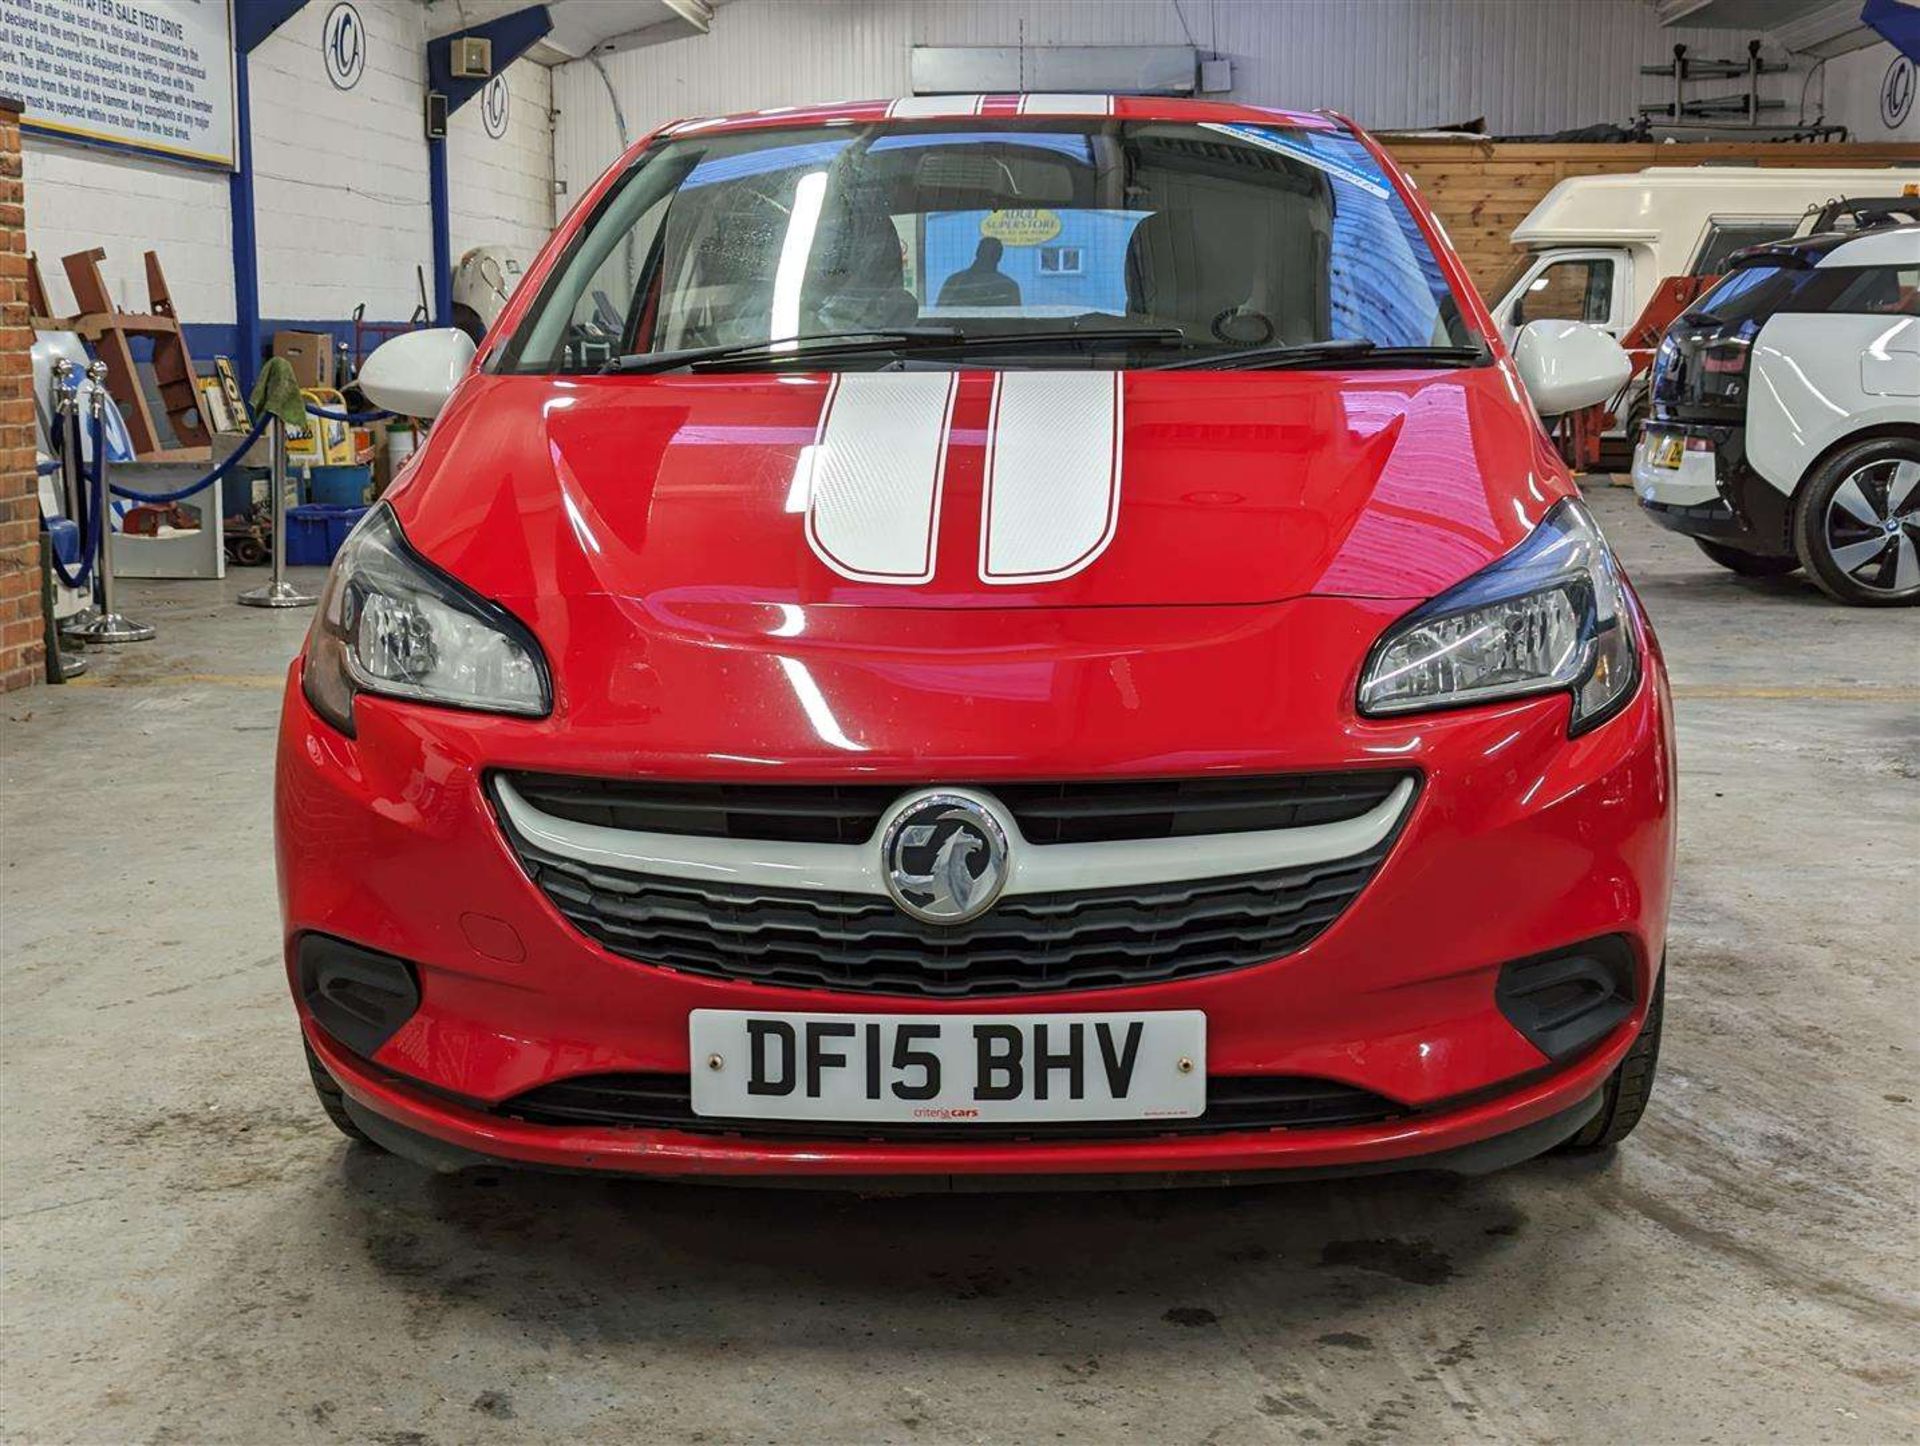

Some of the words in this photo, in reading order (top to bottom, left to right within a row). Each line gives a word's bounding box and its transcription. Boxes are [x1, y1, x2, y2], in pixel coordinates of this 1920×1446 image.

[4, 10, 38, 32] declared
[40, 22, 49, 35] on
[49, 24, 61, 39] the
[62, 29, 80, 47] entry
[106, 40, 120, 56] test
[120, 46, 136, 61] drive
[137, 51, 158, 67] covers
[33, 2, 43, 14] an
[44, 3, 60, 19] after
[61, 10, 76, 25] sale
[77, 14, 91, 29] test
[110, 24, 124, 39] this
[124, 28, 140, 43] shall
[141, 32, 149, 46] be
[115, 3, 138, 26] SALE
[139, 10, 159, 33] TEST
[160, 18, 184, 41] DRIVE
[11, 30, 24, 48] list
[25, 35, 33, 49] of
[34, 36, 55, 56] faults
[56, 46, 83, 64] covered
[92, 54, 123, 74] displayed
[131, 64, 142, 79] the
[19, 51, 34, 69] The
[36, 57, 52, 73] after
[54, 63, 68, 78] sale
[69, 66, 83, 82] test
[83, 70, 101, 87] drive
[101, 76, 118, 91] must
[118, 79, 128, 93] be
[5, 70, 20, 86] one
[20, 72, 40, 89] hour
[40, 76, 57, 94] from
[58, 81, 70, 97] the
[82, 88, 90, 102] of
[90, 90, 102, 105] the
[131, 99, 144, 117] Any
[26, 94, 45, 110] must
[45, 96, 56, 112] be
[56, 102, 87, 120] reported
[746, 1018, 942, 1101] DF15
[972, 1020, 1145, 1101] BHV
